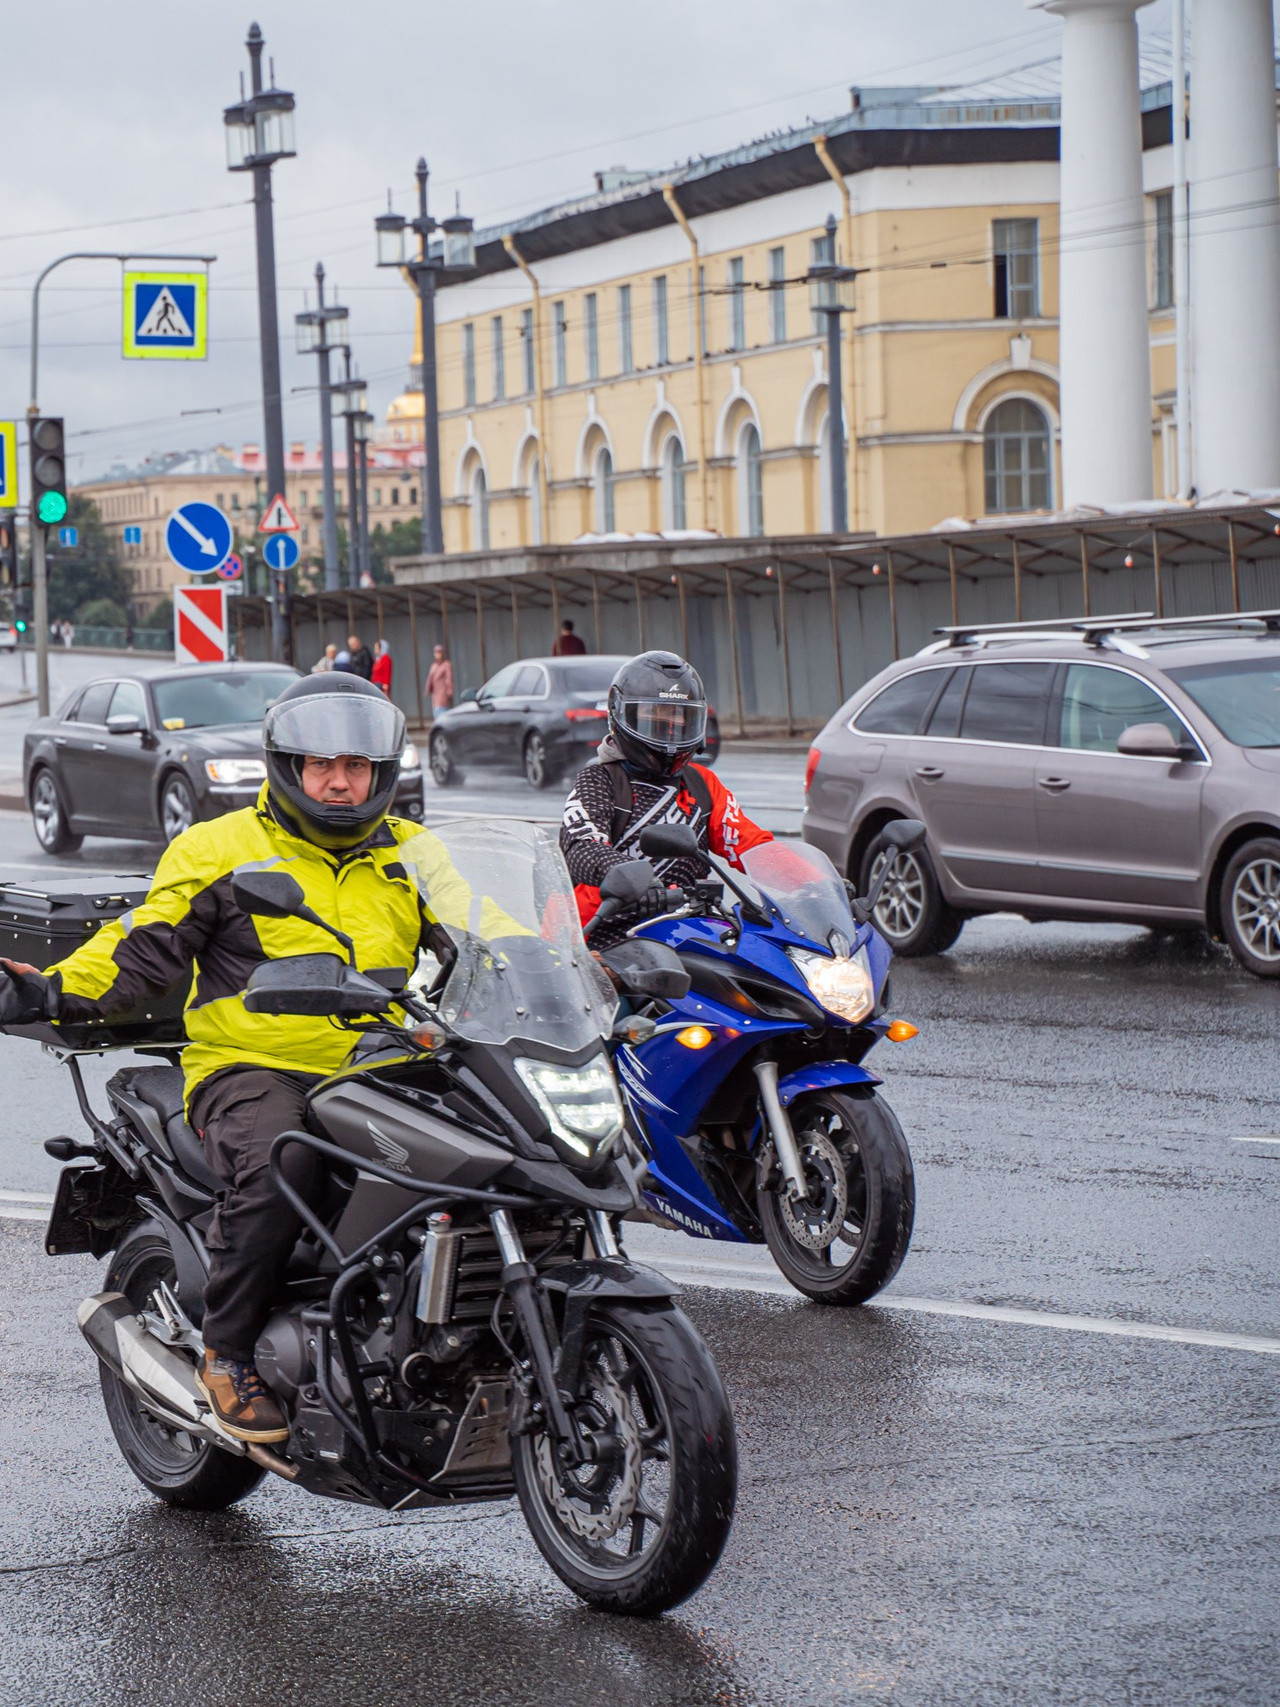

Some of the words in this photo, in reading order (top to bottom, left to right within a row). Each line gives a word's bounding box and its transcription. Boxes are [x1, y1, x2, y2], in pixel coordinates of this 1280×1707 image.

[659, 692, 689, 700] SHARK
[371, 1157, 413, 1174] HONDA
[655, 1198, 713, 1239] YAMAHA
